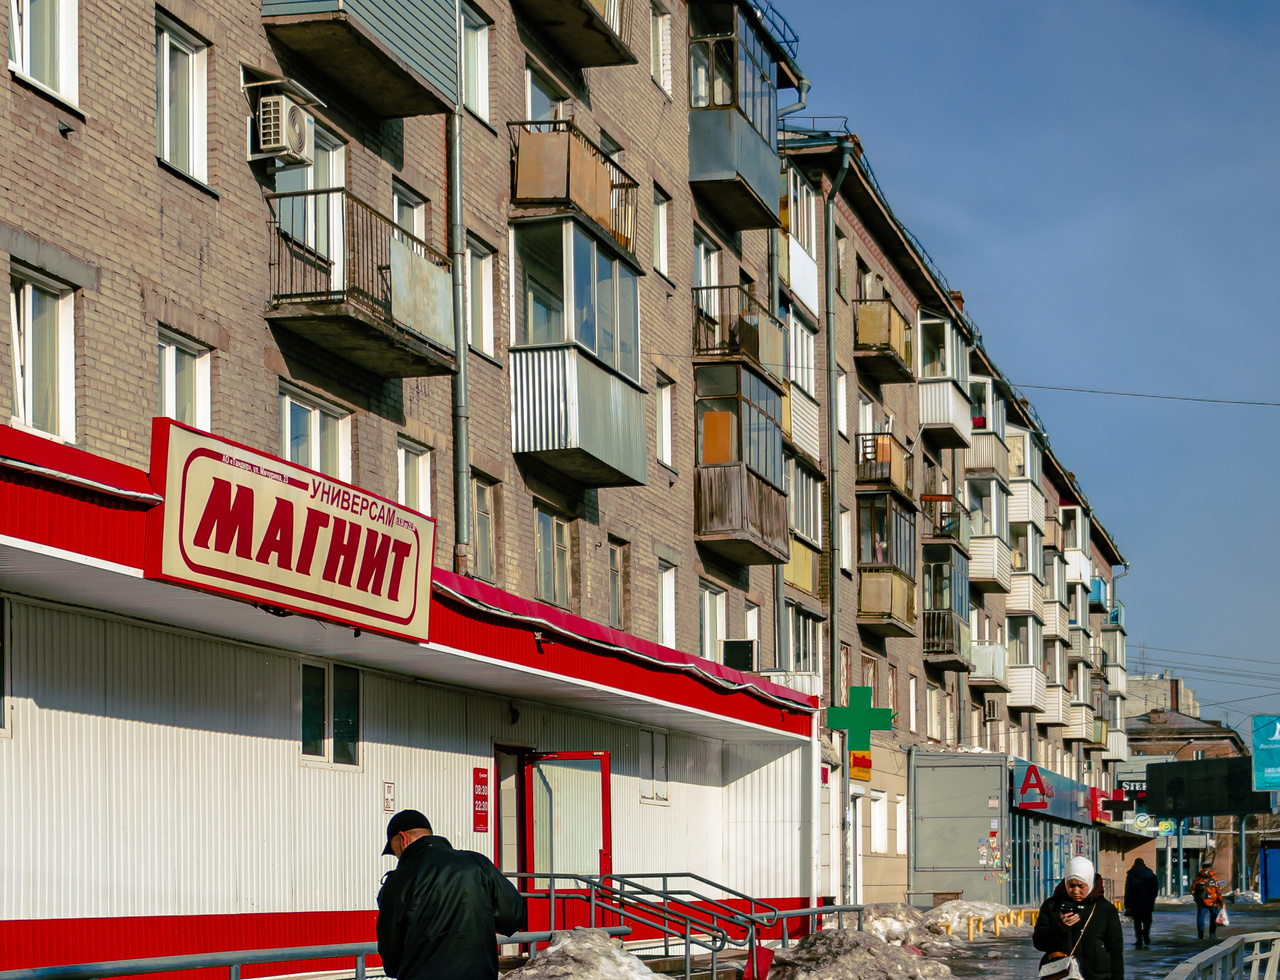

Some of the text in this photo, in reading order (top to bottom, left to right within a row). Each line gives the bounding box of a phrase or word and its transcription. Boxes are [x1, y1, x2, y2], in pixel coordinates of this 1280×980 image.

[310, 478, 396, 528] УНИВЕРСАМ
[193, 476, 412, 603] МАГНИТ
[475, 800, 488, 811] 22:30
